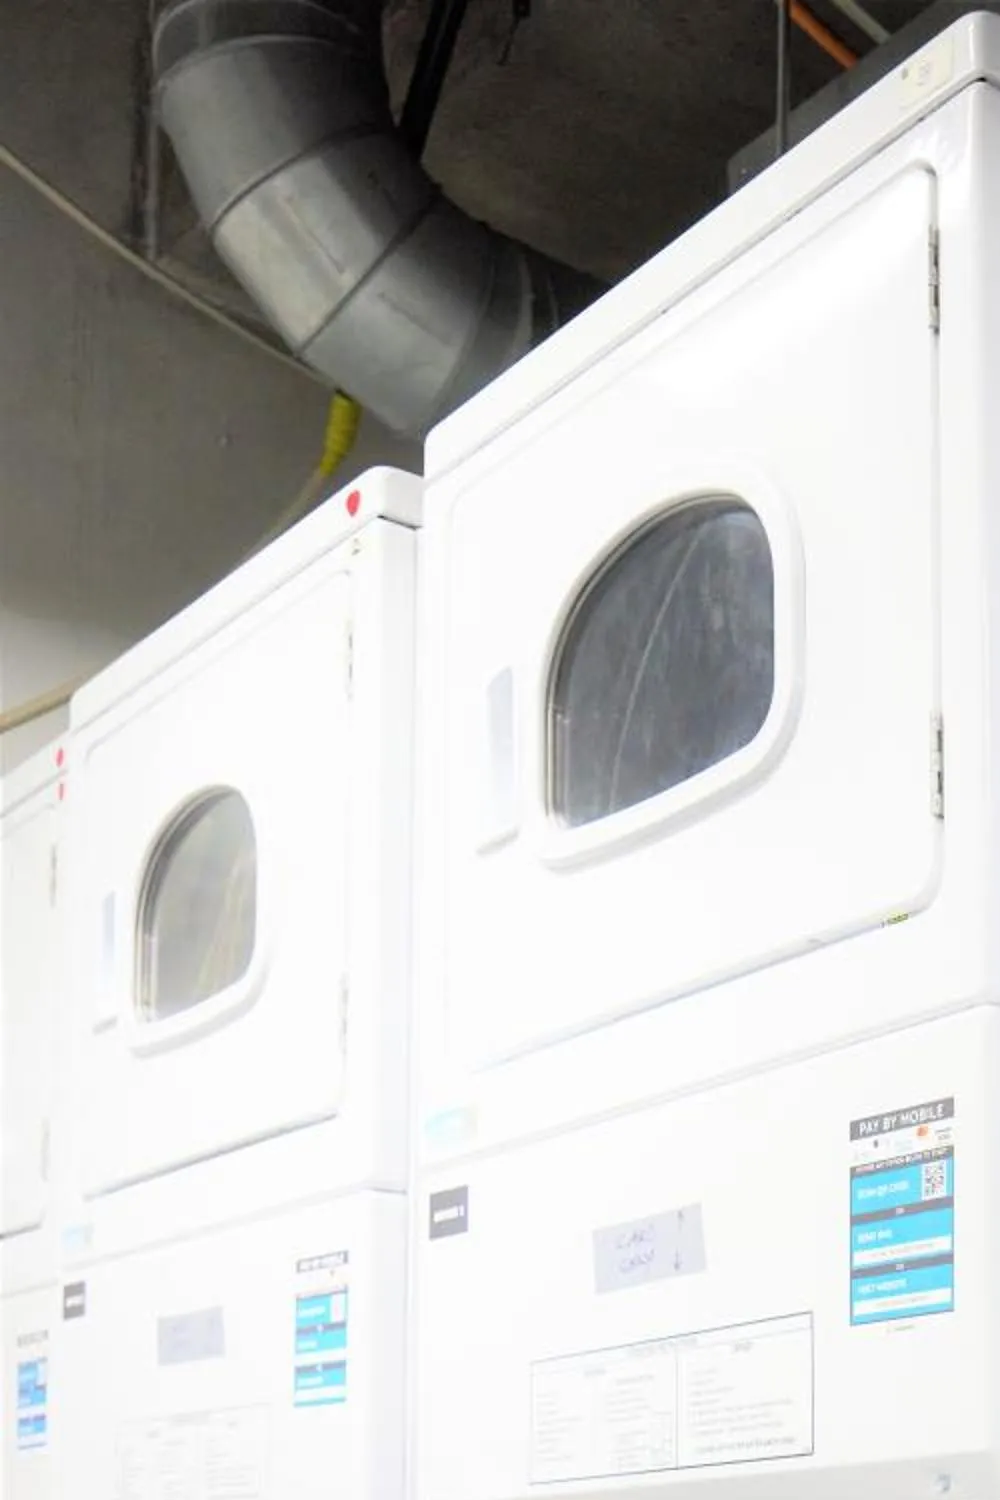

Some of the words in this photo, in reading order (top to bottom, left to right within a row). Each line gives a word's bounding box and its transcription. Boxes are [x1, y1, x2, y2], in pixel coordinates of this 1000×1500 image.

[859, 1119, 880, 1136] PAY
[882, 1115, 897, 1131] BY
[901, 1103, 945, 1123] MOBILE
